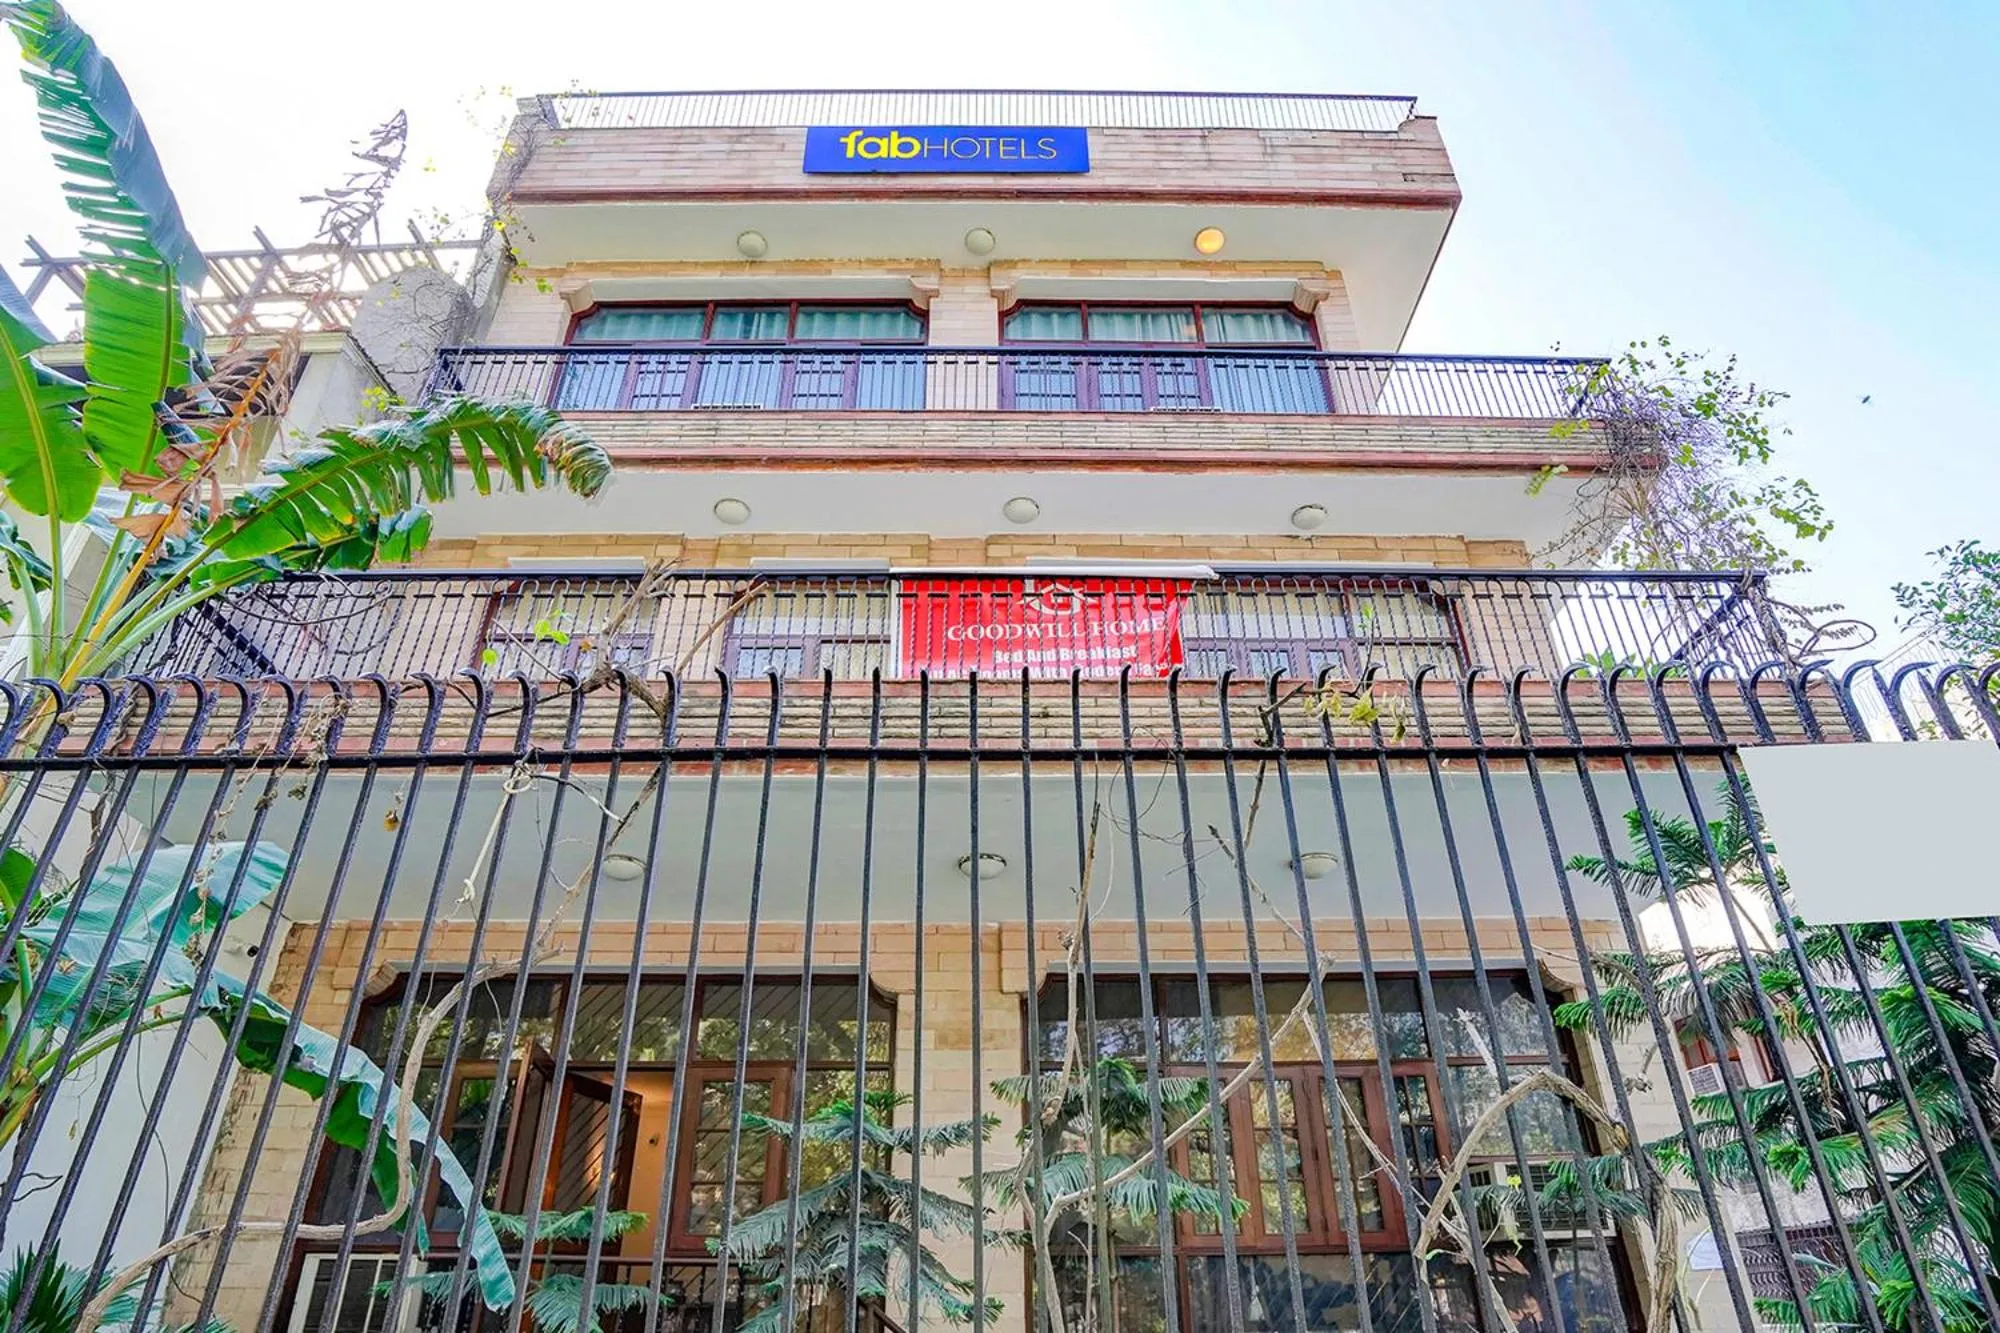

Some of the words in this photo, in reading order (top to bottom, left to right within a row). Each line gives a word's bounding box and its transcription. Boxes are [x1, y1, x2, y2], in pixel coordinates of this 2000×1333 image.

[947, 622, 1087, 641] GOODWILL
[1092, 616, 1166, 636] HOME
[993, 649, 1023, 663] Bed
[1027, 648, 1056, 662] And
[1060, 644, 1137, 660] Breakfast
